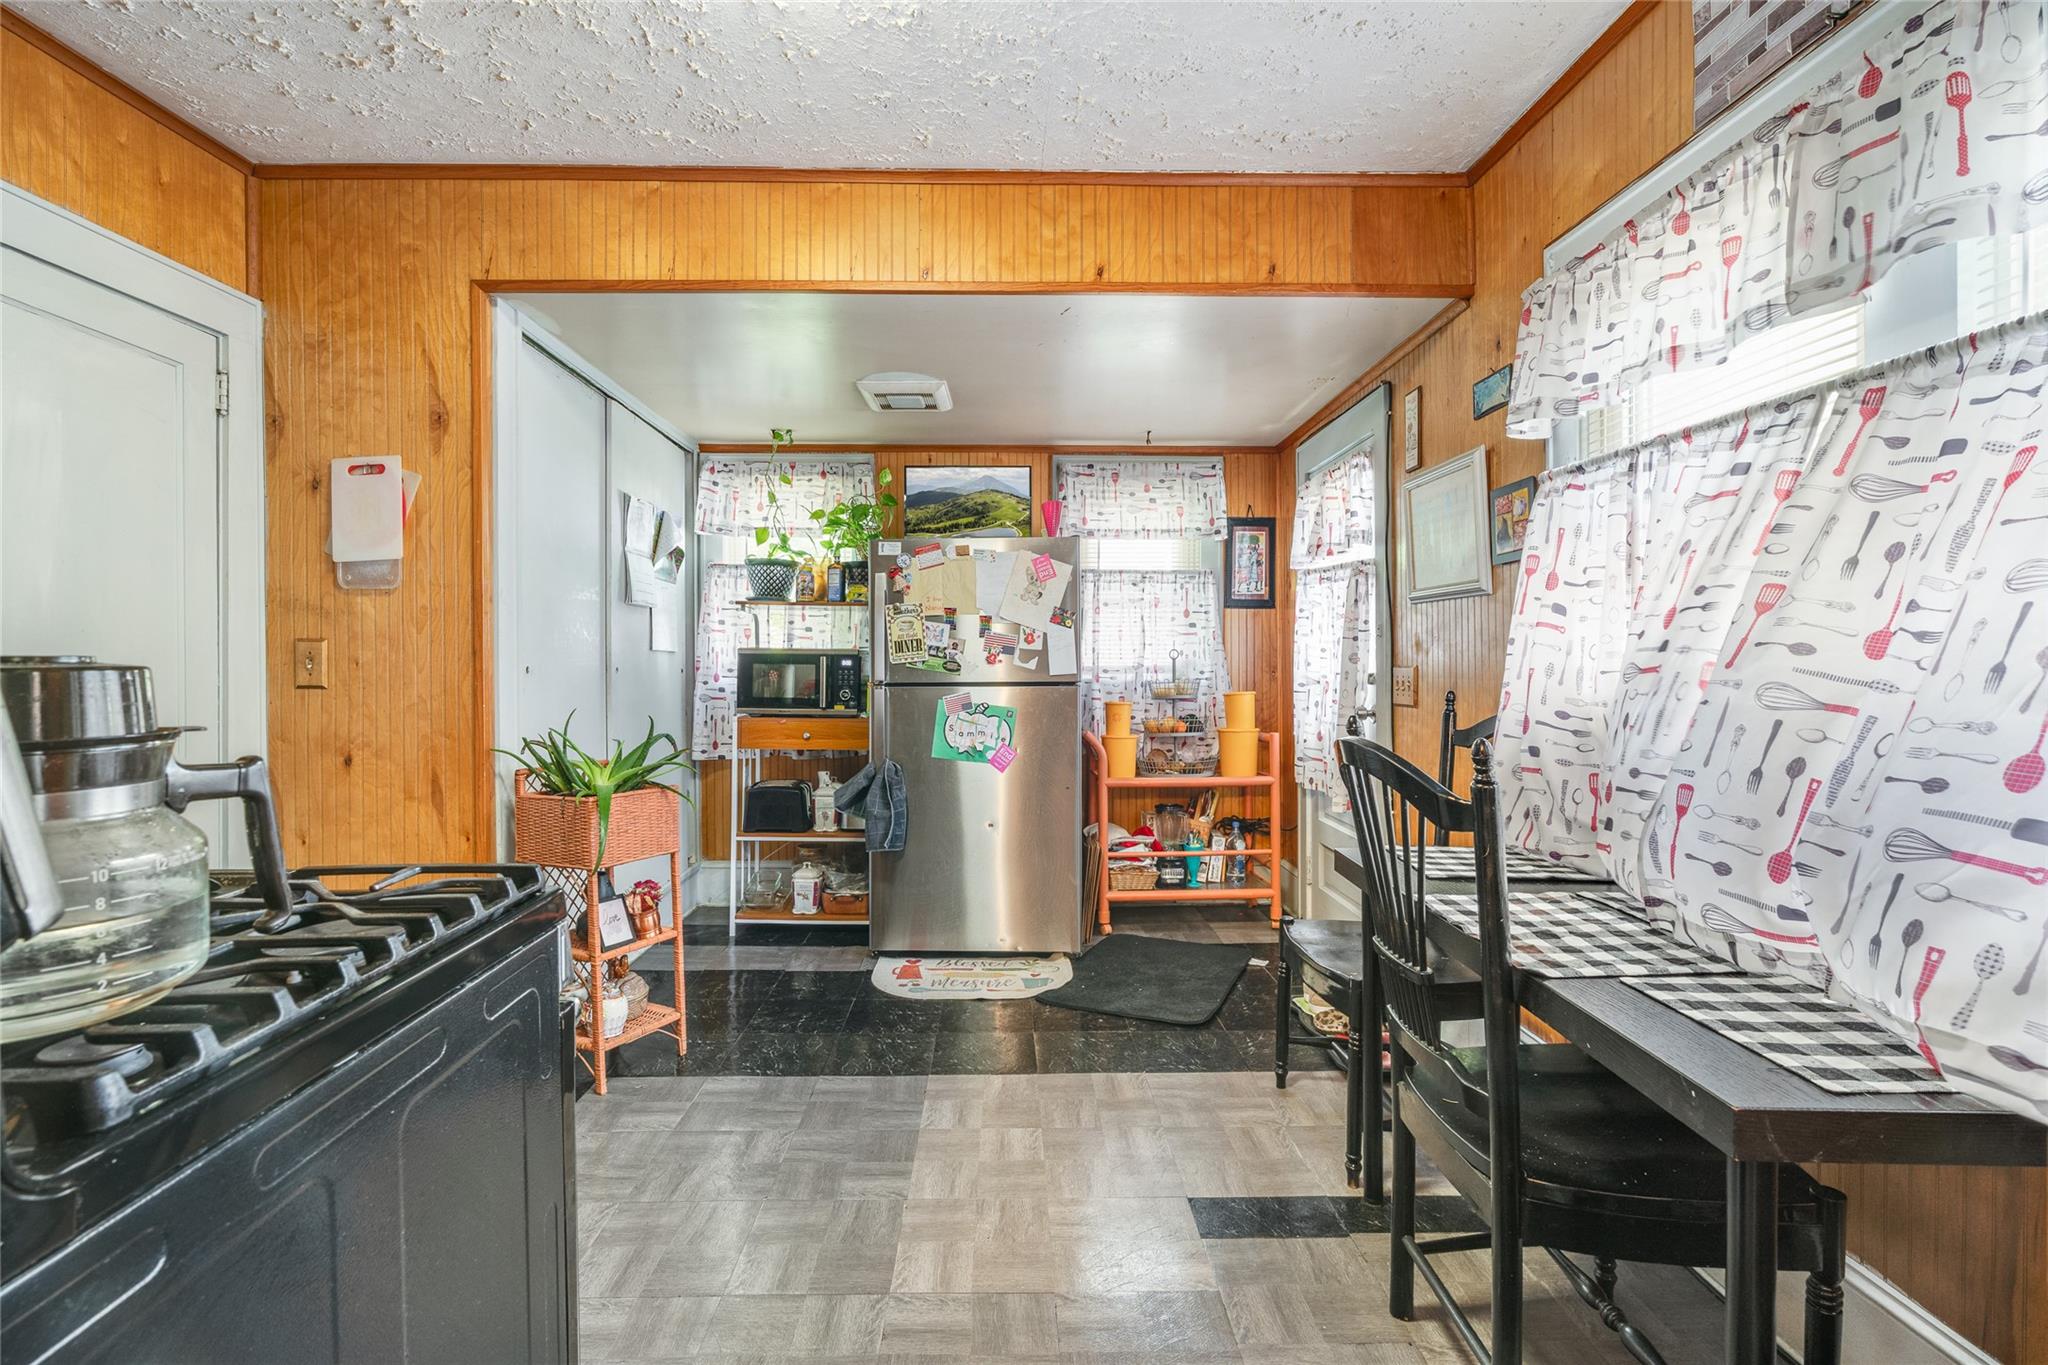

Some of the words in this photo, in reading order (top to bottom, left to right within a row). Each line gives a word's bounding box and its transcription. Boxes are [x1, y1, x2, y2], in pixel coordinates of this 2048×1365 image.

[893, 638, 924, 654] DINER
[91, 868, 109, 883] 10
[95, 897, 106, 911] 8
[95, 952, 107, 965] 4
[97, 979, 108, 993] 2
